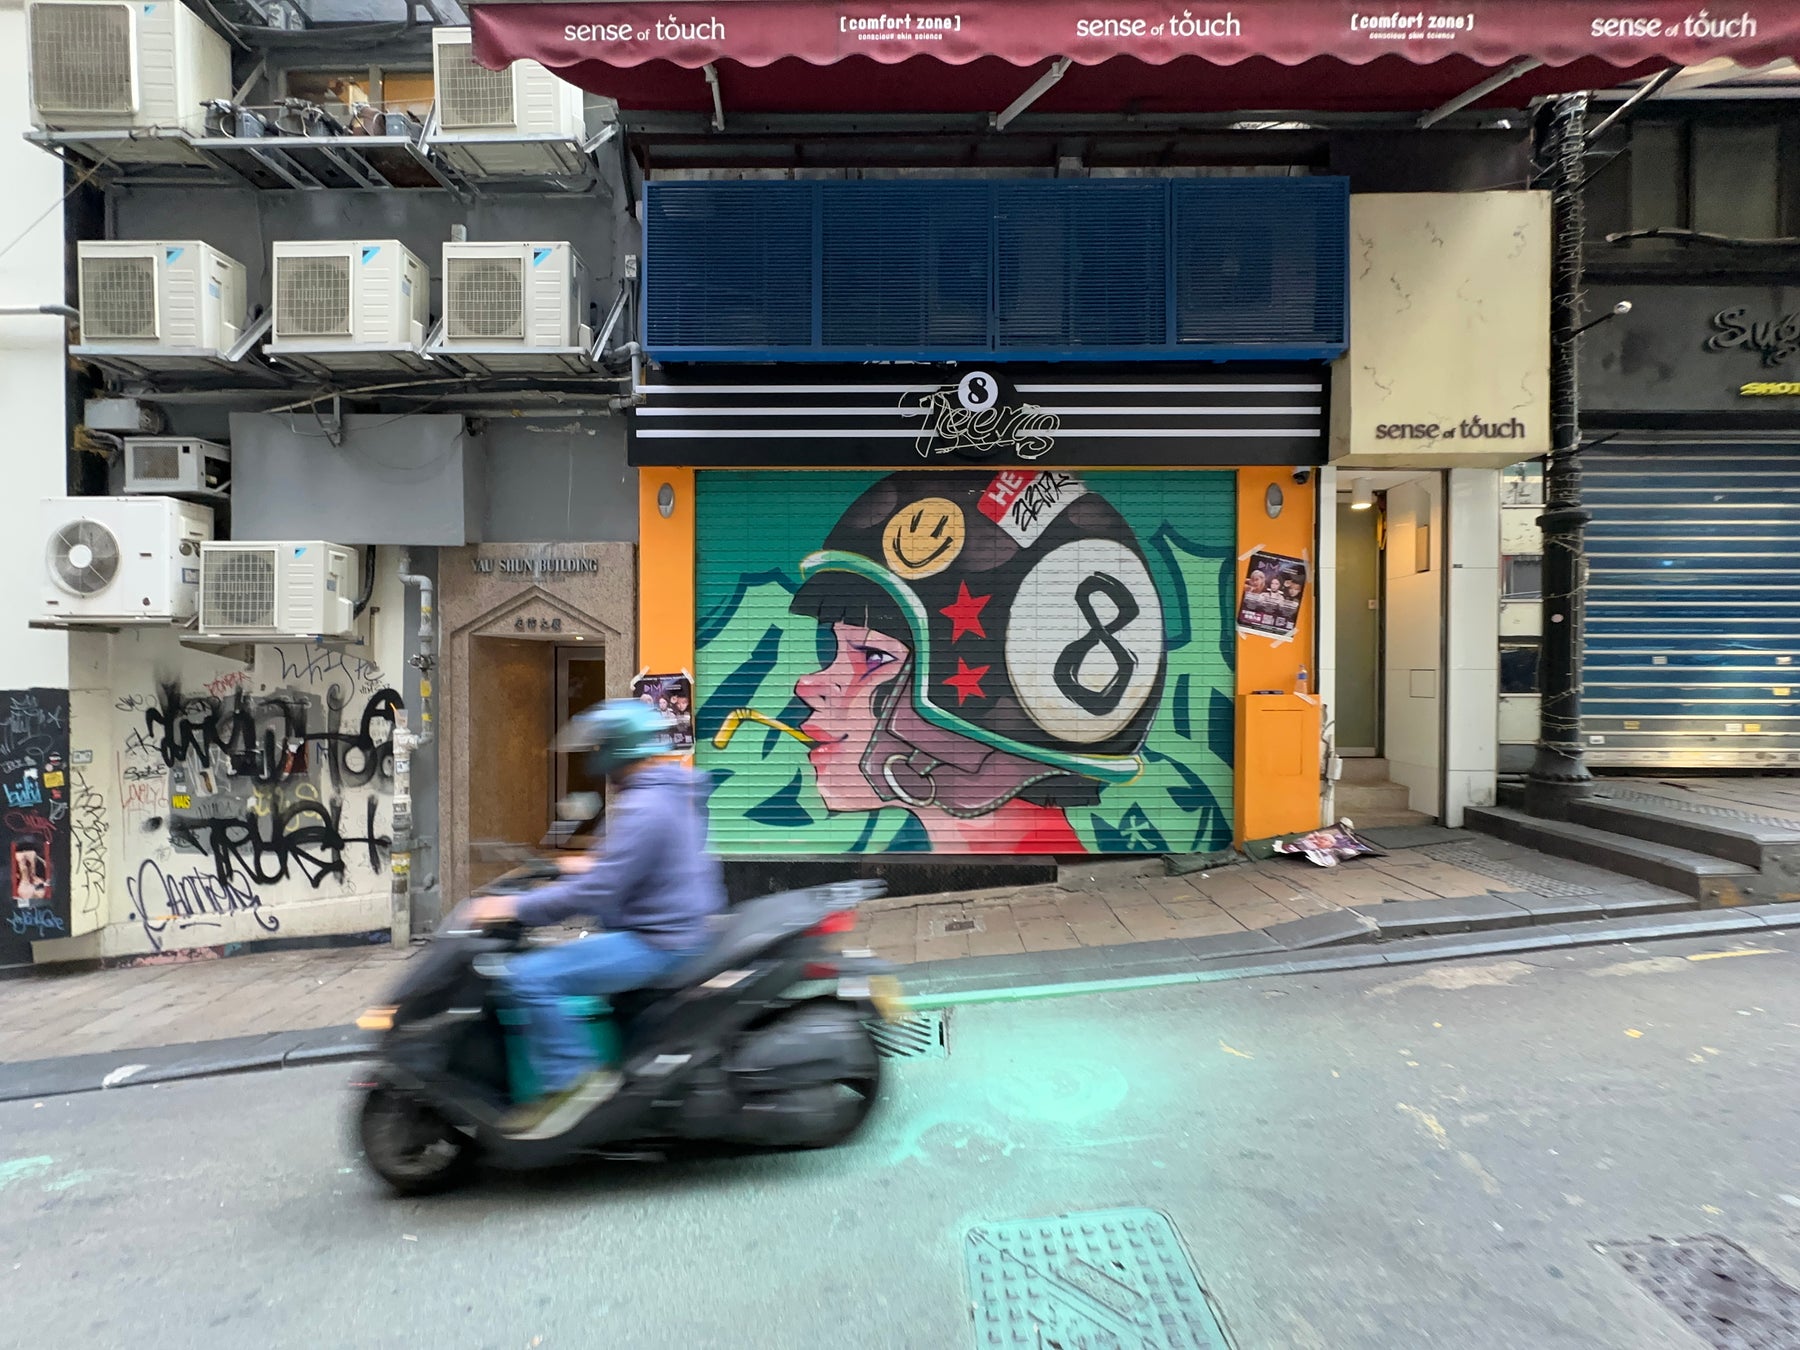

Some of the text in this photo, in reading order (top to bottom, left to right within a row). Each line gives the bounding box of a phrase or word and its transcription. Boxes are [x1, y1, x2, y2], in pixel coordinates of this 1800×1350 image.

[564, 15, 725, 41] sense of touch
[1077, 10, 1241, 36] sense of touch
[1591, 9, 1757, 37] sense of touch
[967, 377, 989, 404] 8
[1375, 415, 1525, 439] sense of touch
[471, 559, 598, 573] YAU SHUN BUILDING
[1053, 571, 1141, 716] 8
